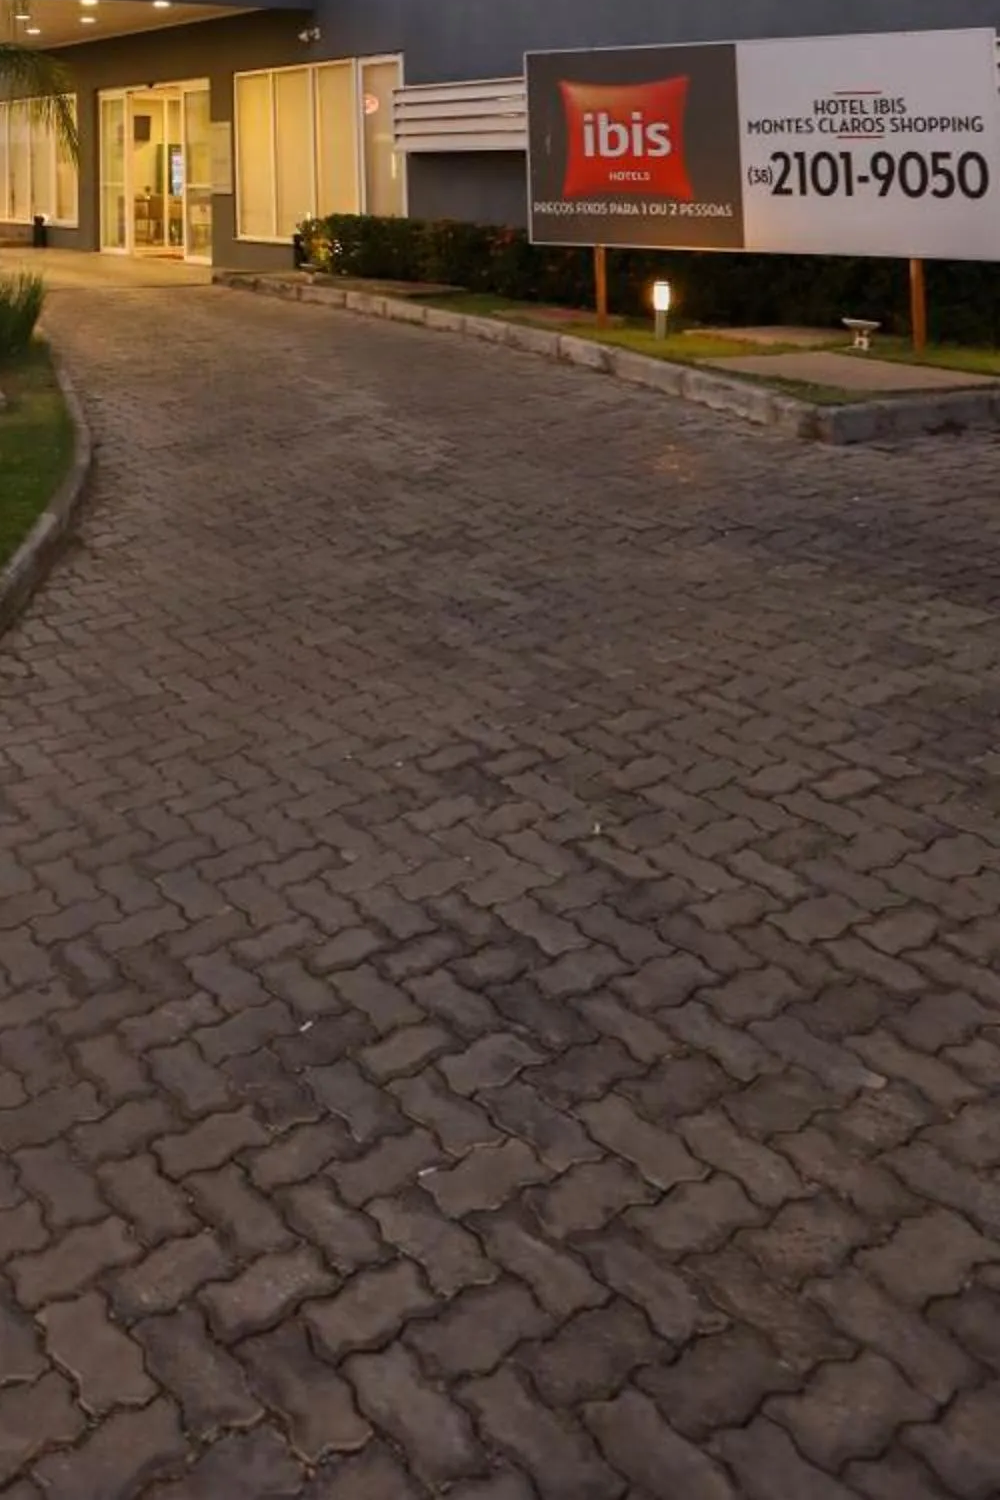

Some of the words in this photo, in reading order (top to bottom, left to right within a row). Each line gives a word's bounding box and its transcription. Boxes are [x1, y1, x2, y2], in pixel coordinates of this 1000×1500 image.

[813, 99, 869, 115] HOTEL
[872, 97, 907, 115] IBIS
[747, 118, 815, 134] MONTES
[818, 117, 885, 133] CLAROS
[889, 115, 984, 133] SHOPPING
[583, 111, 672, 158] ibis
[609, 171, 651, 181] HOTELS
[770, 150, 989, 199] 2101-9050
[609, 202, 639, 216] PARA
[649, 203, 668, 216] OU
[669, 203, 677, 216] 2
[679, 203, 734, 217] PESSOAS
